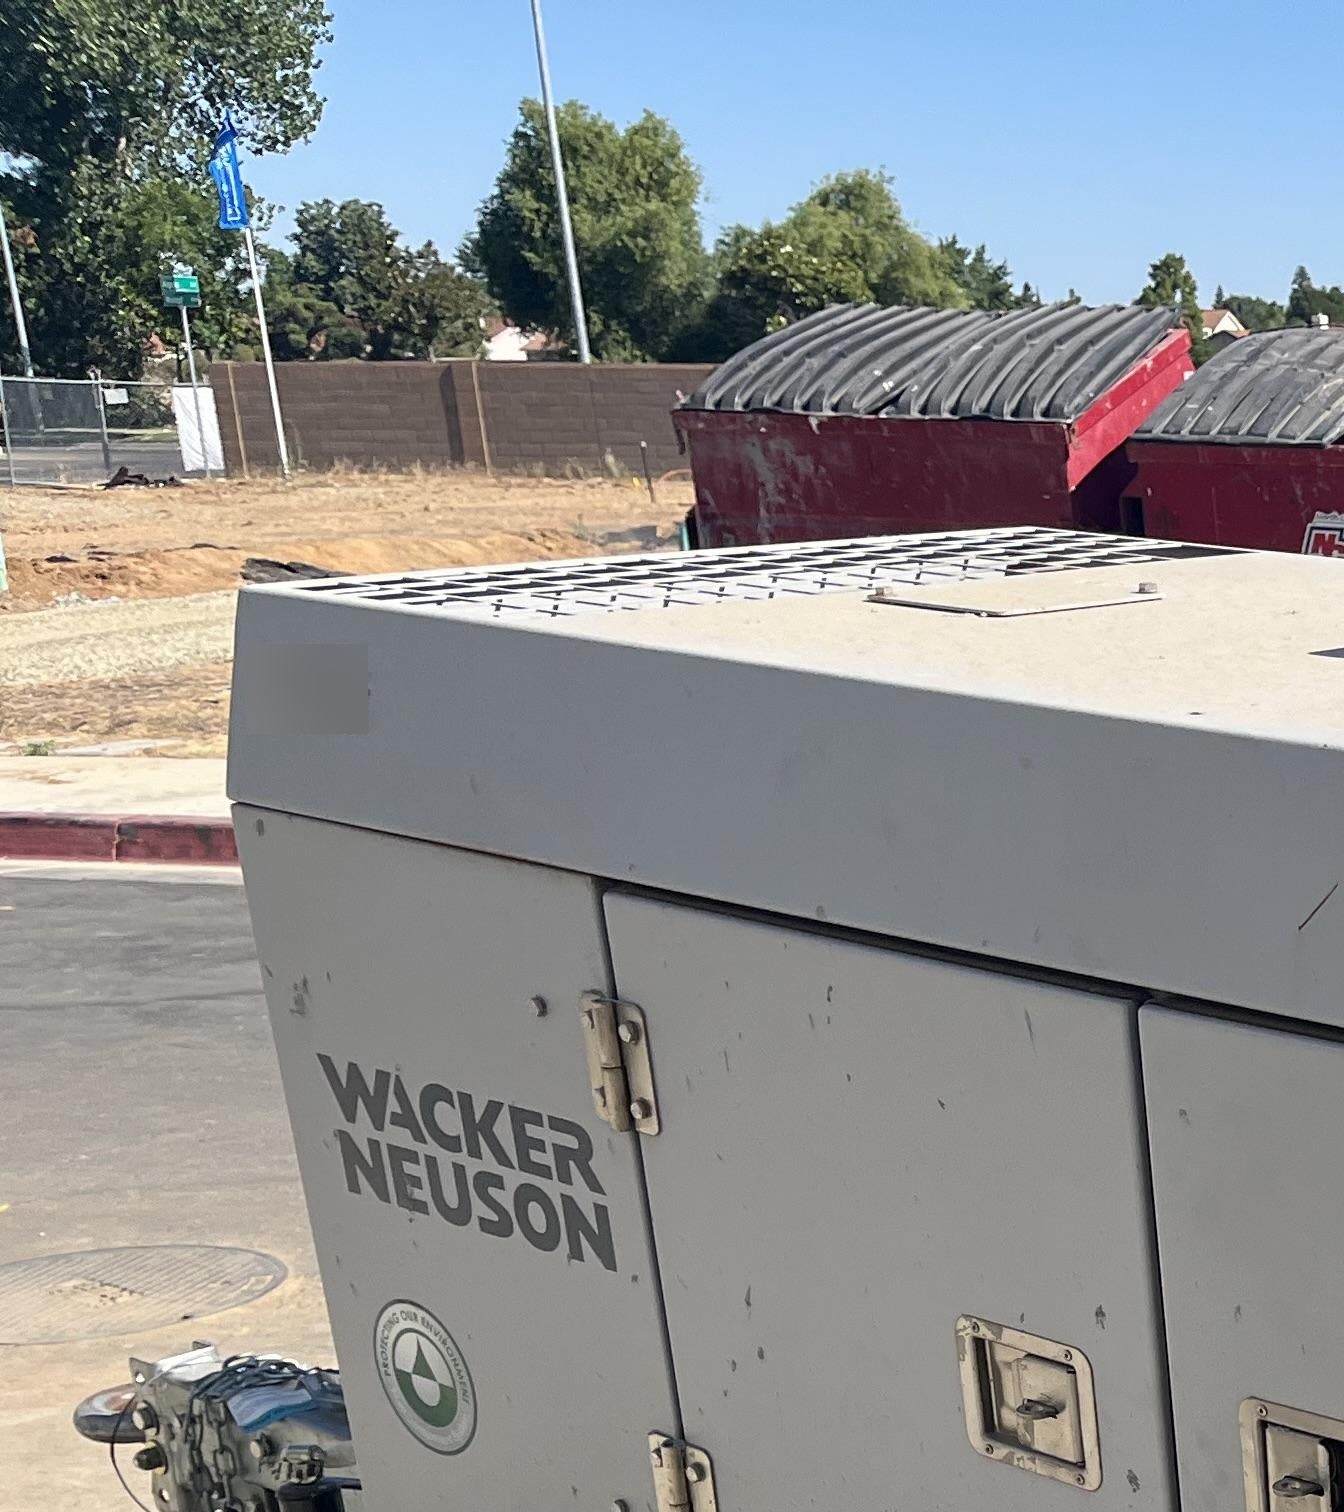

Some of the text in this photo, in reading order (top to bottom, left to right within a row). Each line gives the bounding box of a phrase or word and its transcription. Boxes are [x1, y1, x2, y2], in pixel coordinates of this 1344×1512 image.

[316, 1052, 608, 1197] WACKER
[335, 1128, 618, 1273] NEUSON
[380, 1310, 470, 1405] PROTECTING OUR ENVIRONMENT
